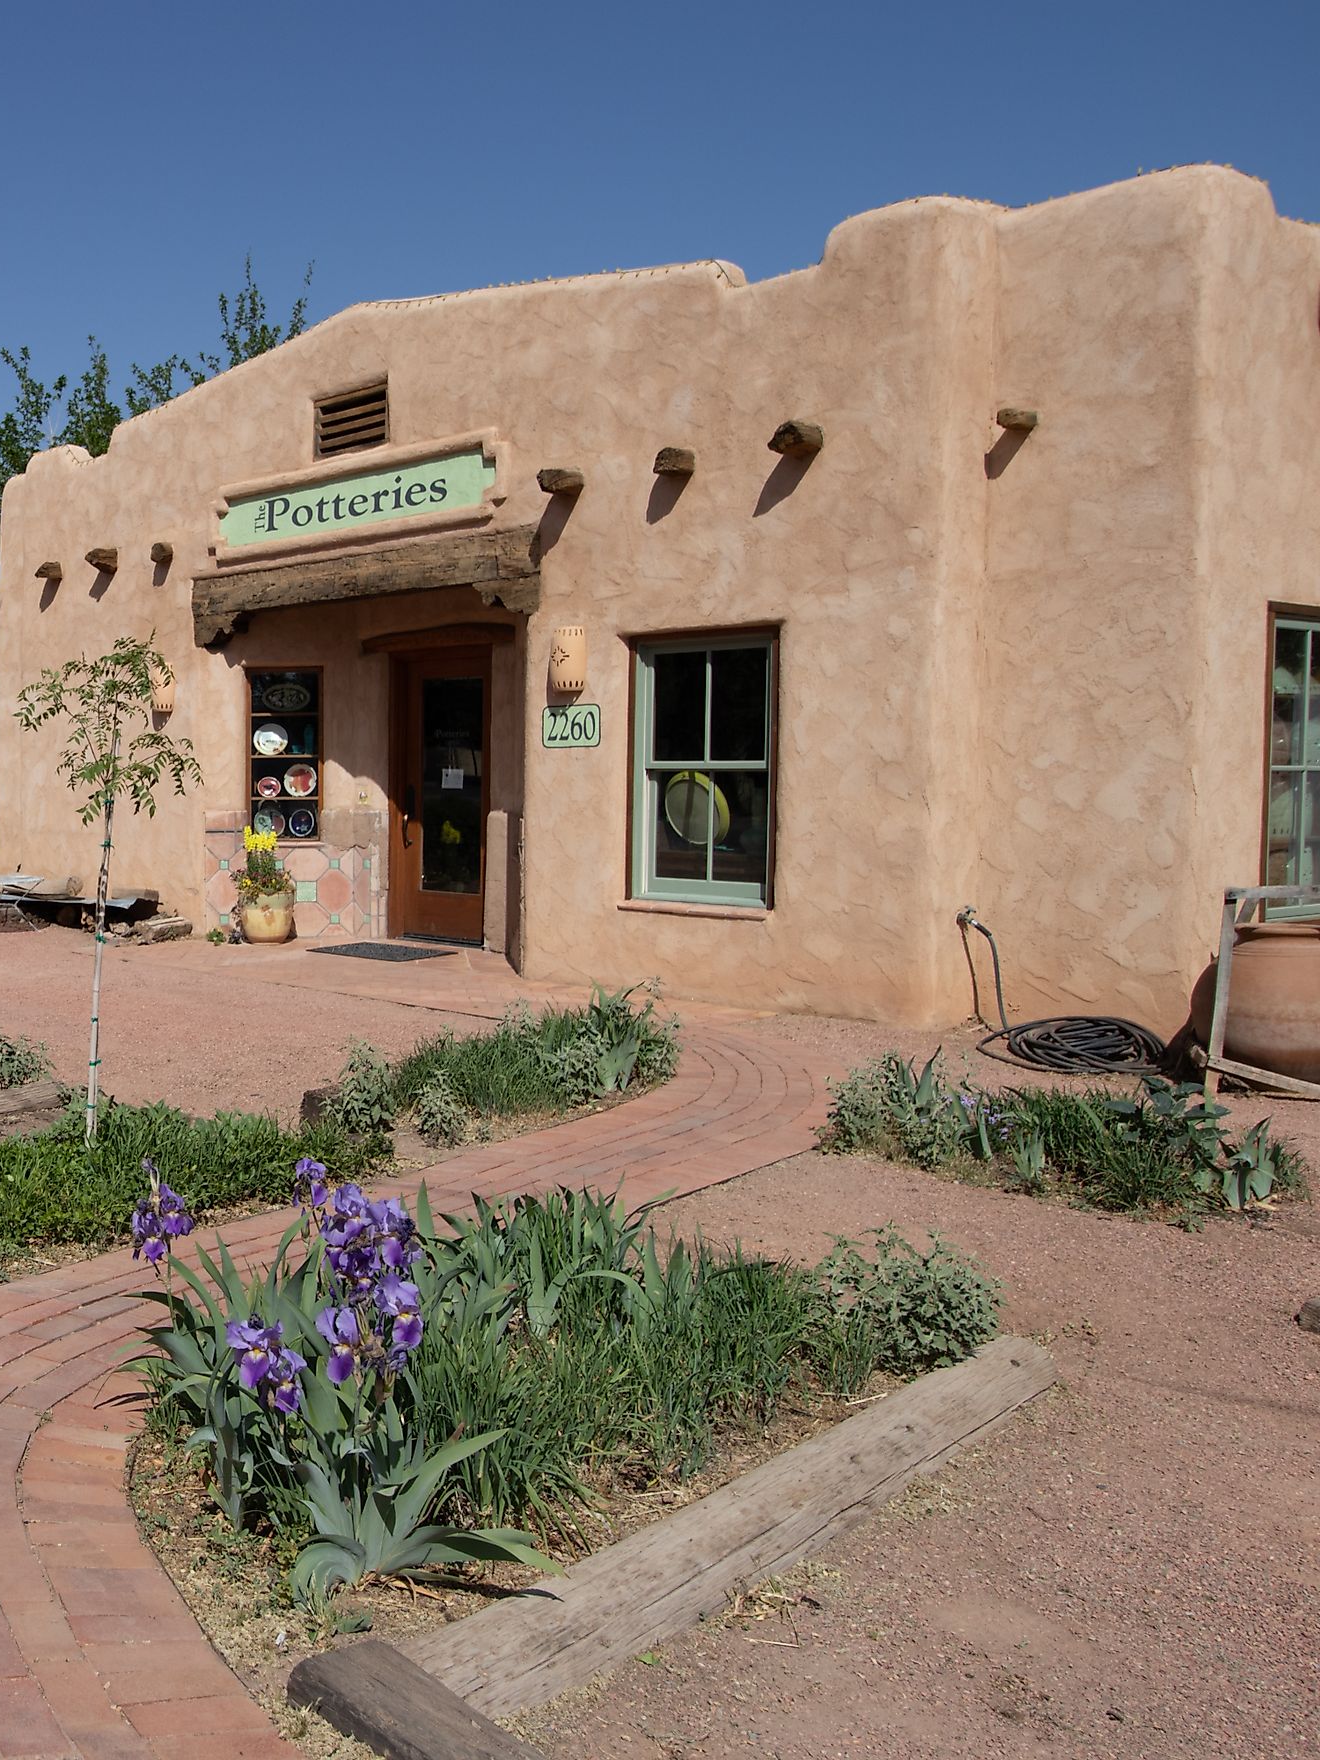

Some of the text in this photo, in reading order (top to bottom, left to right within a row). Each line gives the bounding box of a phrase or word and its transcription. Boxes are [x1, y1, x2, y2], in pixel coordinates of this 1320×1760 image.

[254, 475, 448, 533] The Potteries
[547, 711, 596, 741] 2260
